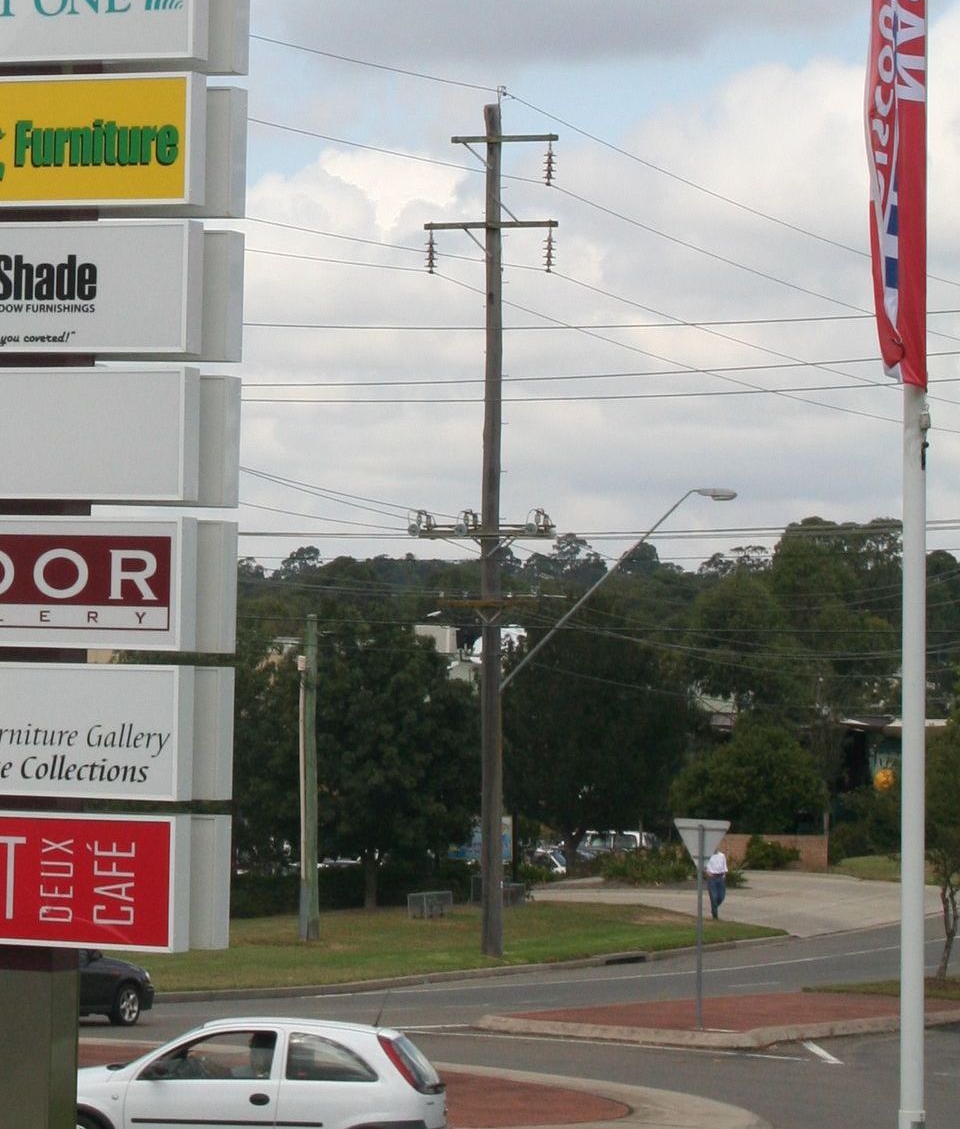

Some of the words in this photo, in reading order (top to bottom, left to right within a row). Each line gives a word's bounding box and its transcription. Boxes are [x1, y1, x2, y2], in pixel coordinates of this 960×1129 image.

[14, 118, 180, 168] Furniture
[25, 303, 96, 313] FURNISHINGS
[86, 723, 172, 759] Gallery
[20, 755, 150, 784] Collections
[40, 837, 74, 923] DEUX
[86, 839, 136, 927] CAFÉ
